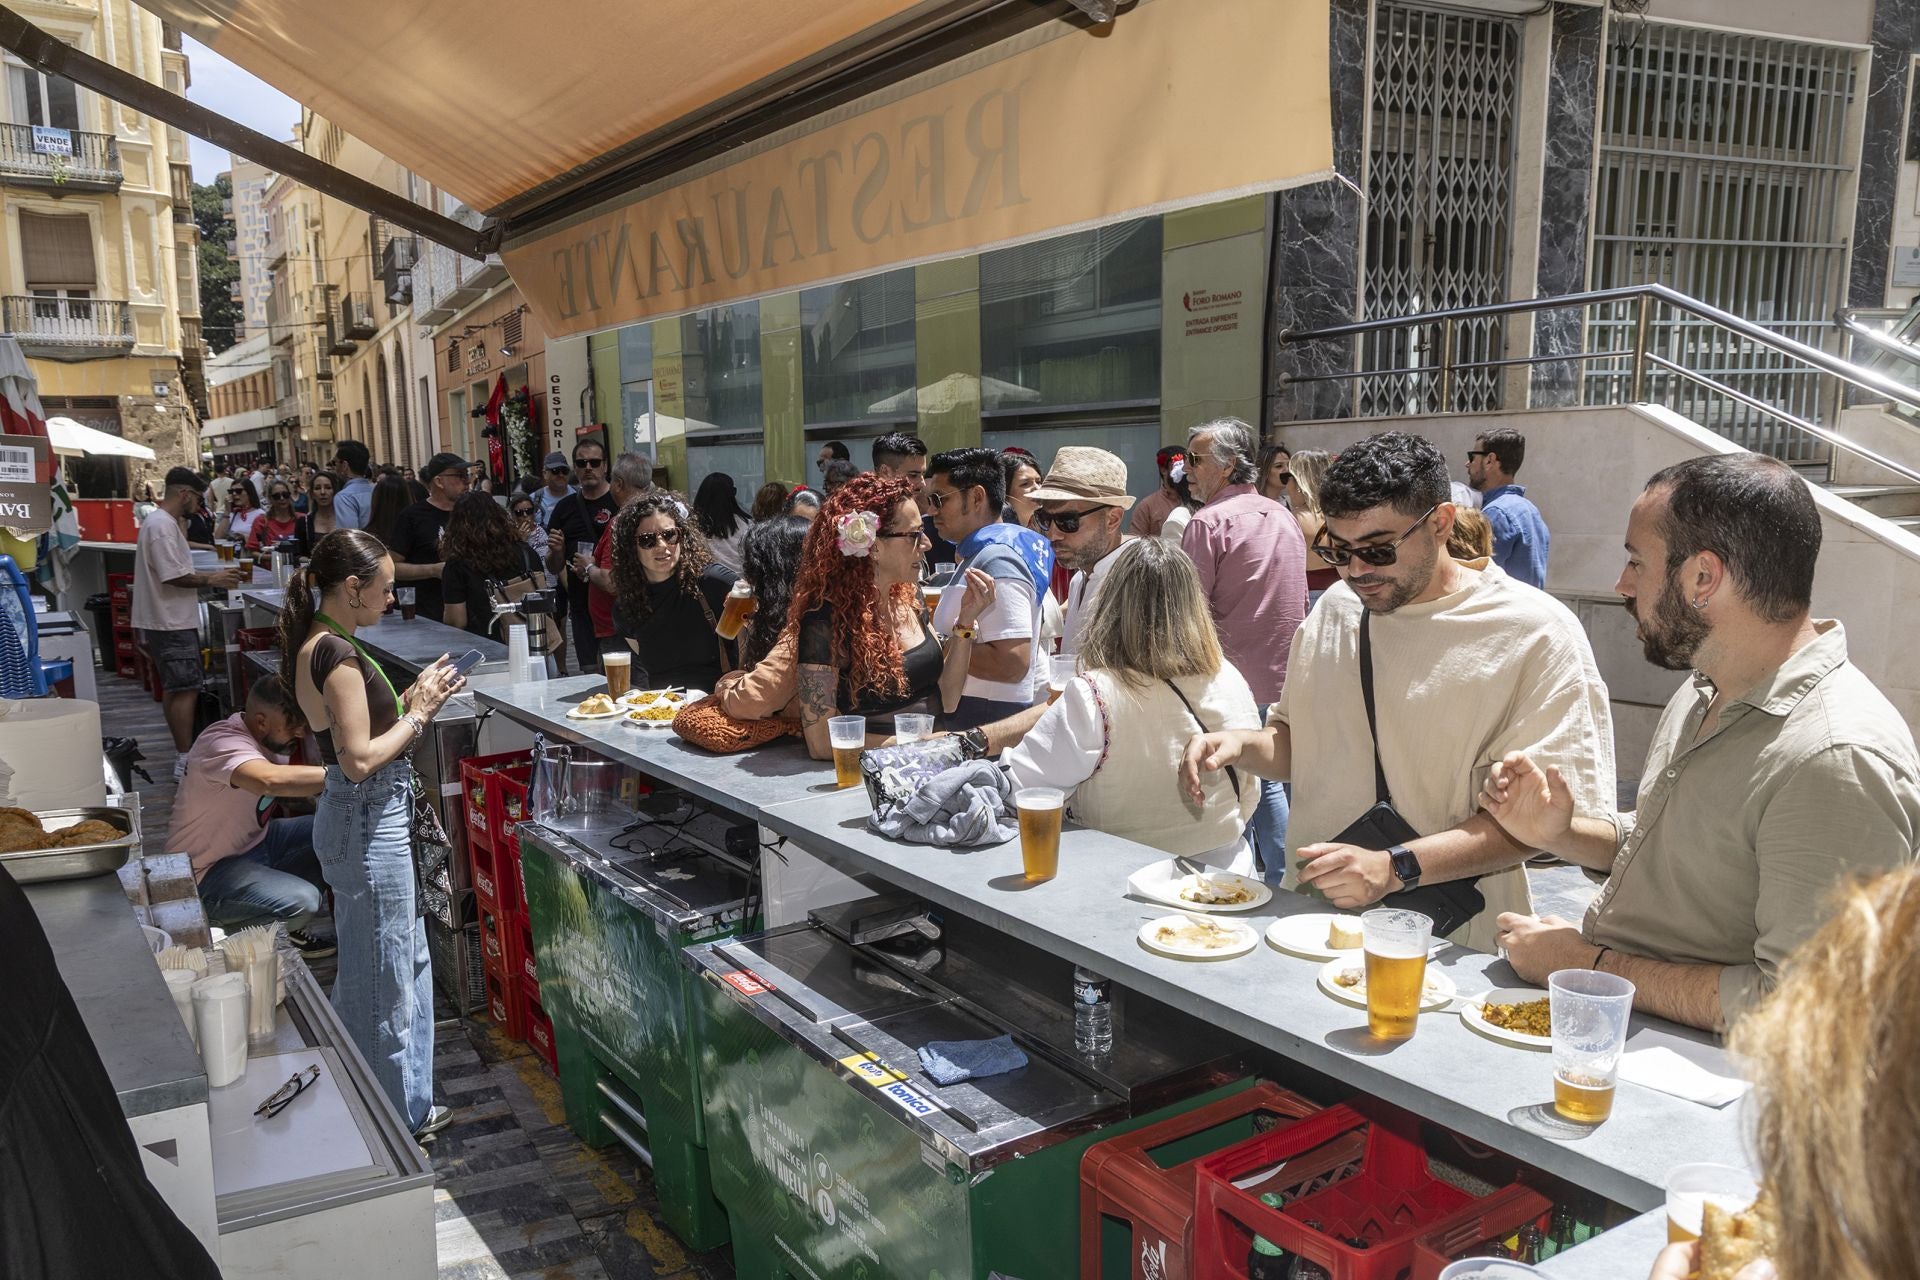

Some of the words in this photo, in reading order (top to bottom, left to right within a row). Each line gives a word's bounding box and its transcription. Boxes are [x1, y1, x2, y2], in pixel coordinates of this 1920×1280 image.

[36, 135, 70, 146] VENDE
[1192, 296, 1211, 306] FORO
[1211, 290, 1243, 303] ROMANO
[1185, 317, 1210, 328] ENTRADA
[1210, 312, 1239, 324] ENFRENTE
[1185, 326, 1212, 337] ENTRANCE
[1073, 984, 1103, 998] EZOYA
[887, 1083, 932, 1114] tonica
[760, 1103, 805, 1152] COMPROMISO
[766, 1132, 807, 1177] HEINEKEN
[764, 1147, 777, 1175] SIN
[777, 1158, 810, 1205] HUELLA
